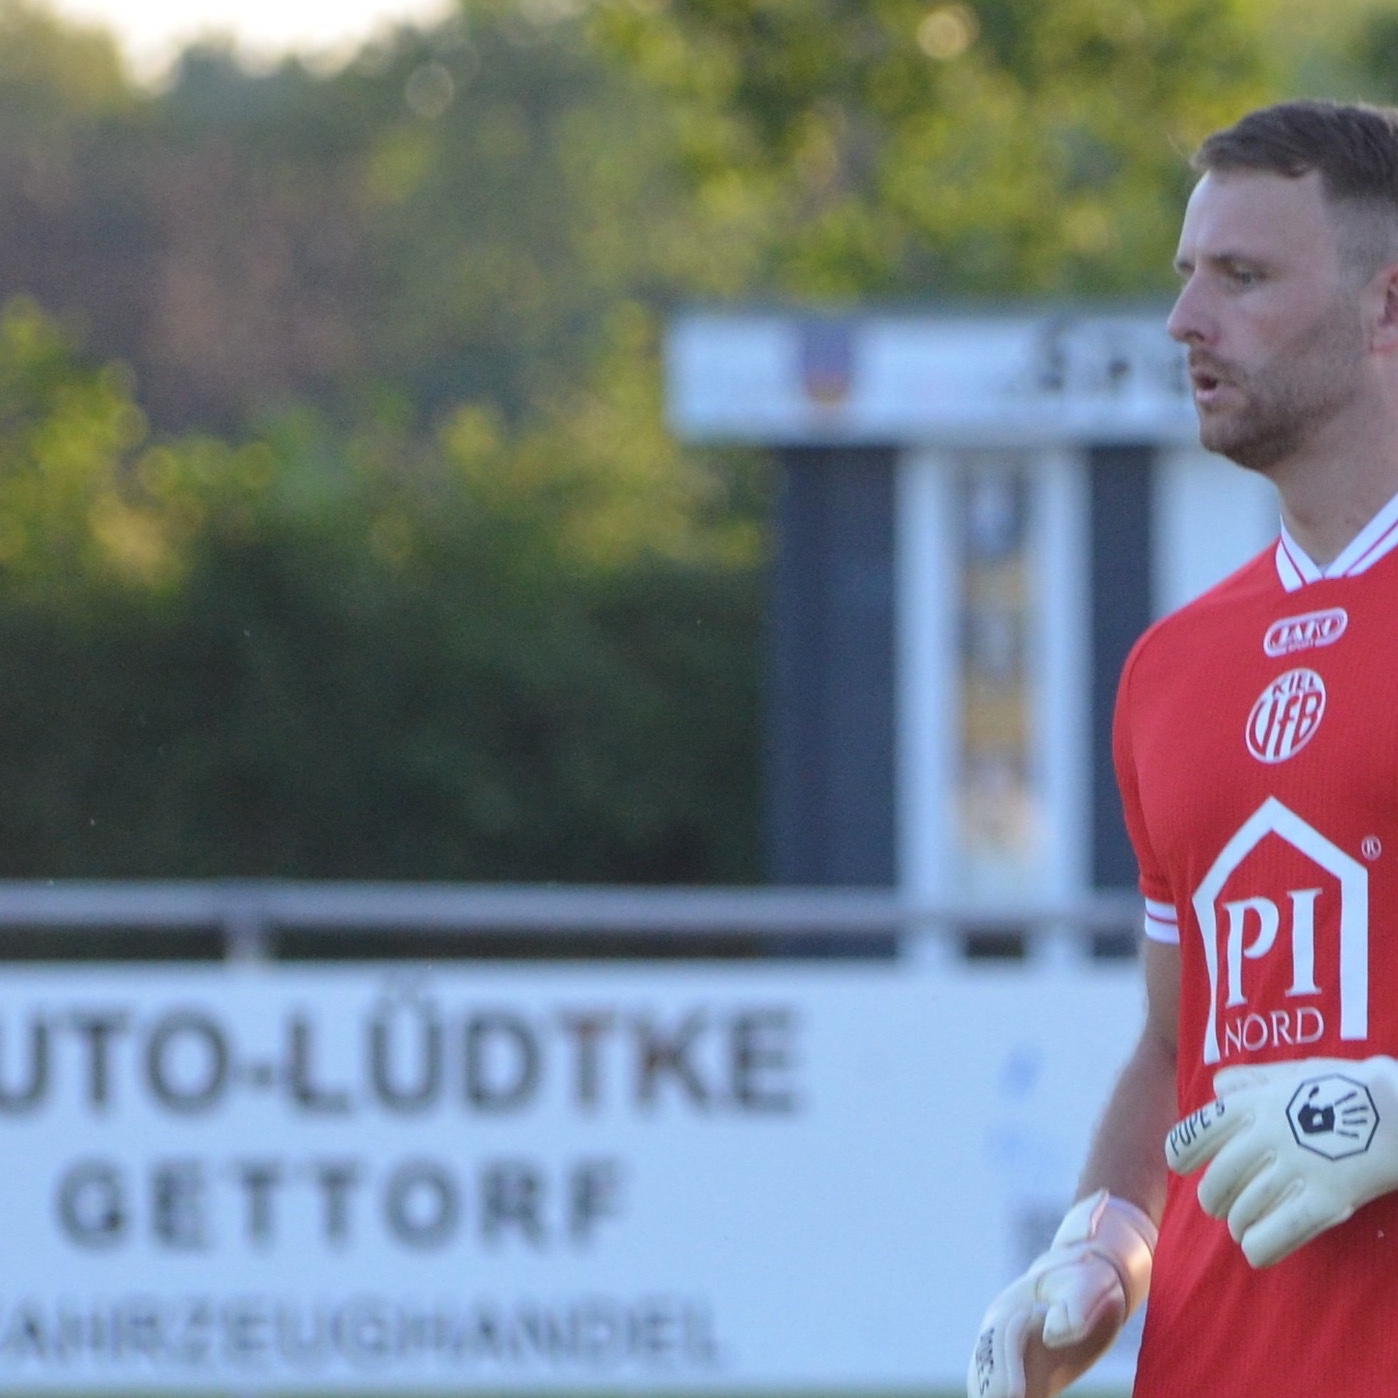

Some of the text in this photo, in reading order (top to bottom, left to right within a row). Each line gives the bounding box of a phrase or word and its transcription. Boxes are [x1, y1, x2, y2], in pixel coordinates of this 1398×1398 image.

[1223, 887, 1324, 1009] PI
[1225, 1007, 1325, 1058] NORD
[55, 1156, 630, 1254] GETTORF
